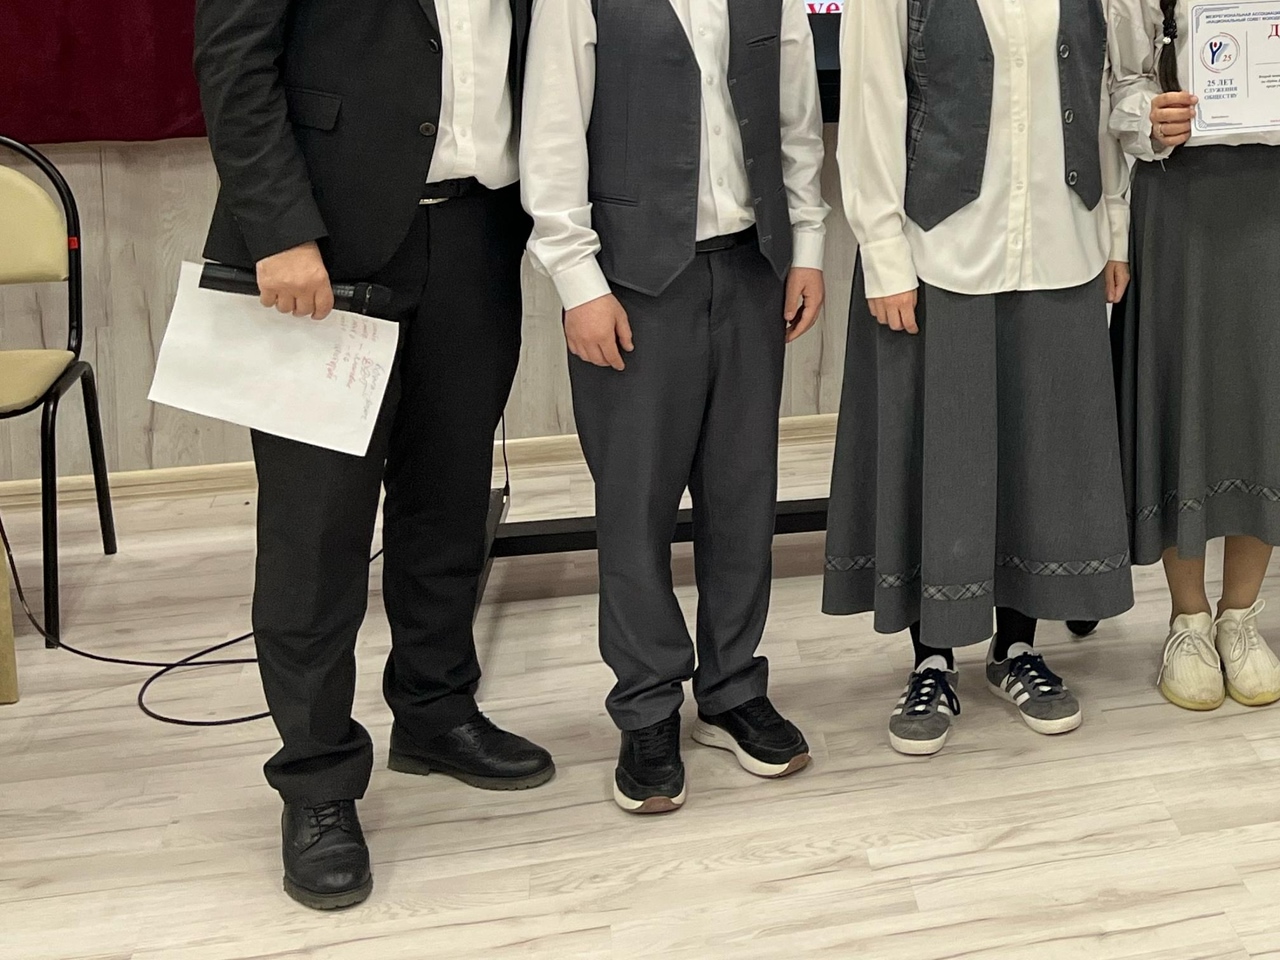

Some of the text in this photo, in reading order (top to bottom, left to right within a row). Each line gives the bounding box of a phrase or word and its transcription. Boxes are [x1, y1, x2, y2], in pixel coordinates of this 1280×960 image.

[1222, 54, 1232, 62] 25
[1207, 78, 1234, 87] 25 ЛЕТ
